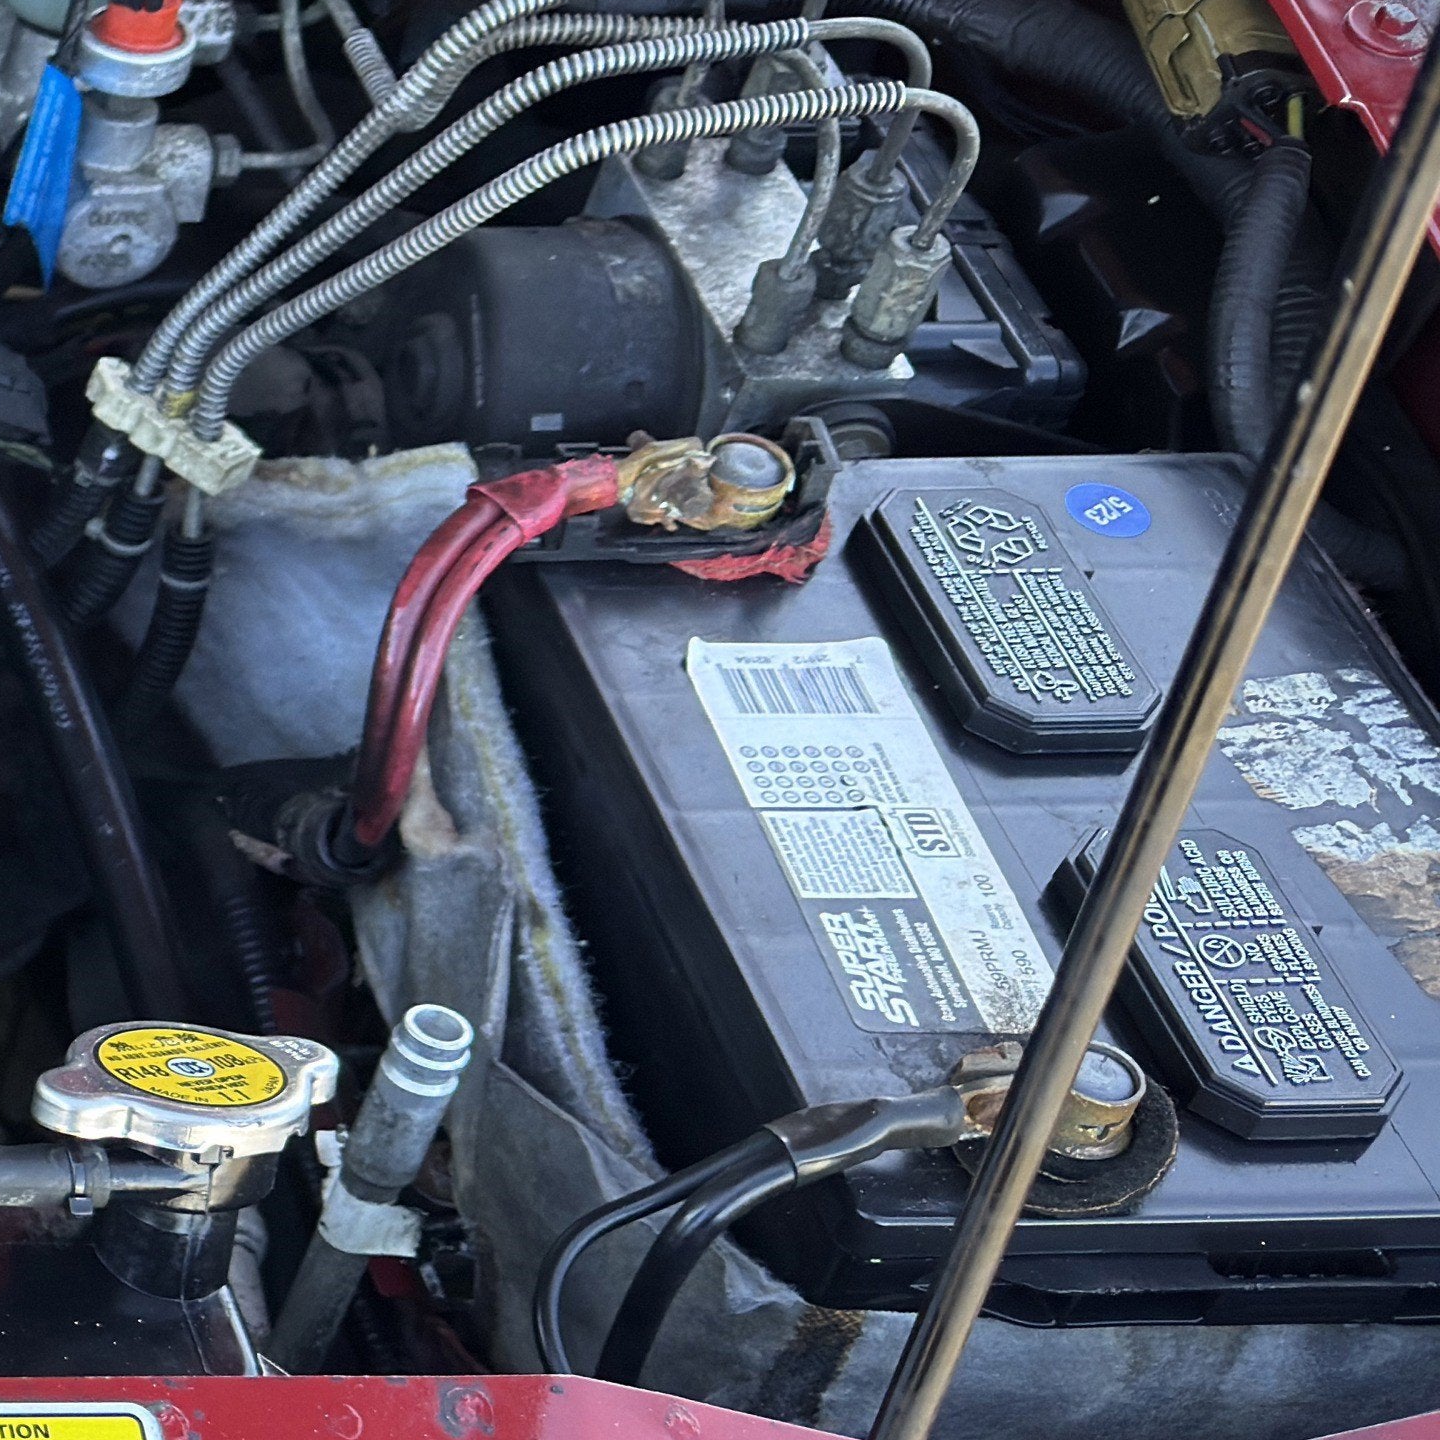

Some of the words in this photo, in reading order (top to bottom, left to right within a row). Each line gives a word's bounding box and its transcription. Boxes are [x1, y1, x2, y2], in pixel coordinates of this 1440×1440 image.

[1083, 494, 1133, 526] 5/23
[1180, 839, 1207, 865] ACID
[819, 912, 876, 1011] SUPER
[841, 912, 920, 1027] START
[1245, 942, 1266, 962] NO
[1256, 933, 1288, 972] SPARKS
[1272, 934, 1303, 972] FLAMES
[1172, 960, 1247, 1052] DANGER
[1230, 982, 1266, 1024] SHIELD
[1255, 994, 1281, 1024] EYES
[1268, 991, 1317, 1050] EXPLOSIVE
[1302, 1013, 1335, 1049] GASES
[115, 1064, 170, 1081] R148
[206, 1054, 243, 1071] 108
[149, 1086, 190, 1100] MADE
[194, 1095, 209, 1103] IN
[218, 1089, 251, 1103] 1.1
